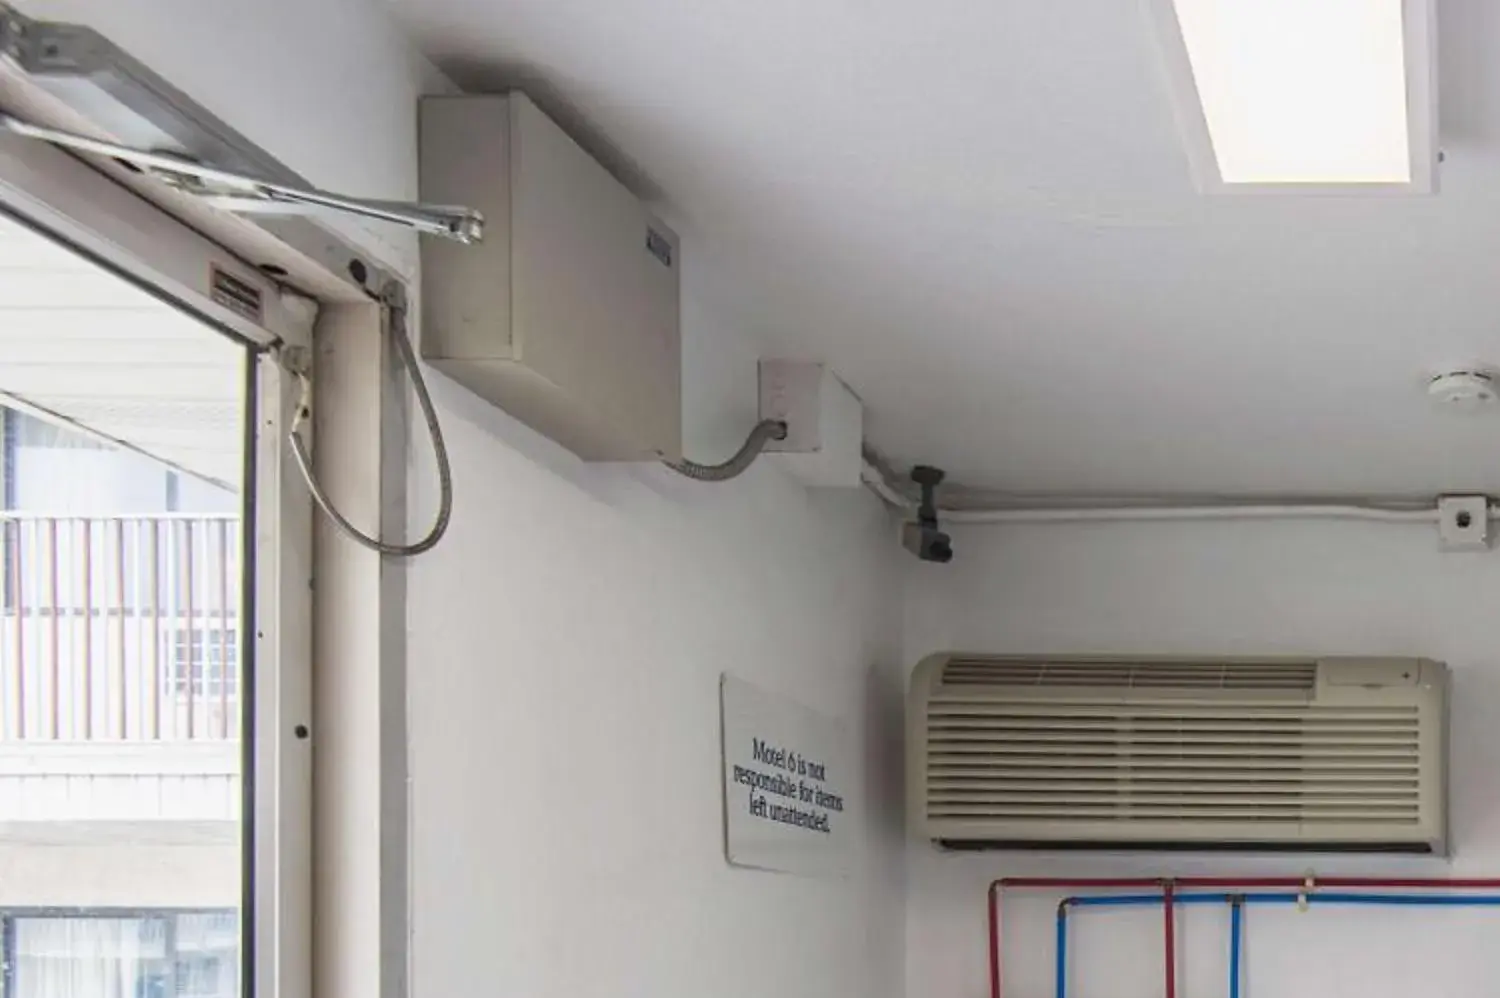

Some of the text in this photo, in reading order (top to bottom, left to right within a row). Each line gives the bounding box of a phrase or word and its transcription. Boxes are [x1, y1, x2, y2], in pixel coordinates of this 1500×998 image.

[752, 737, 826, 782] Motel 6 is not
[733, 764, 844, 812] responsible for items
[749, 791, 831, 834] left unattended.
